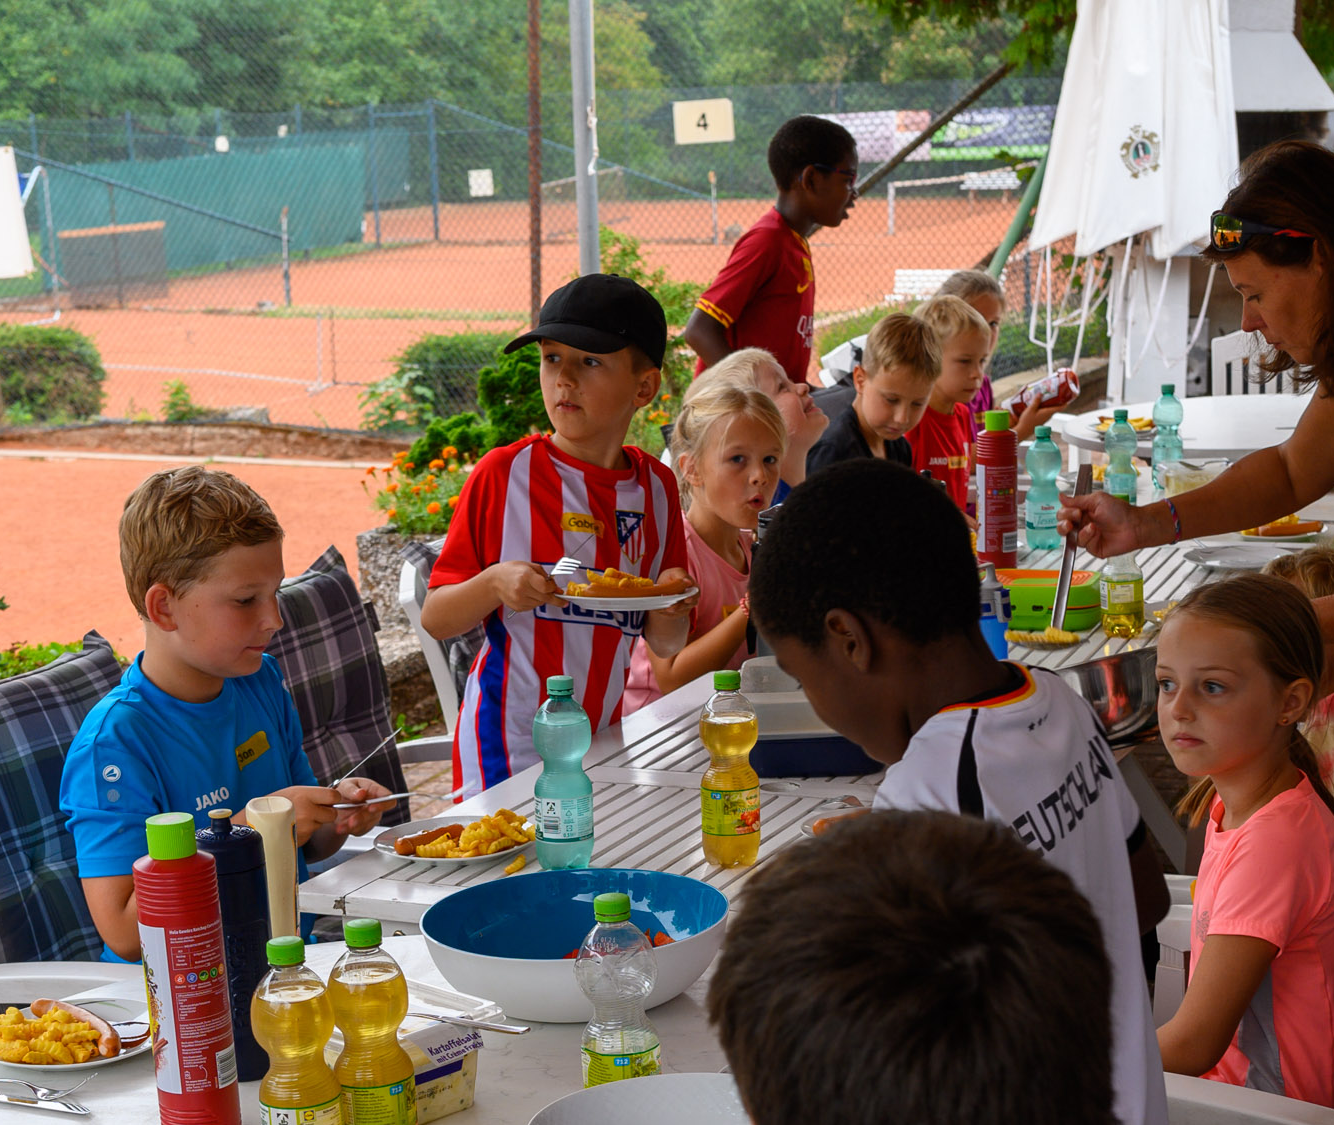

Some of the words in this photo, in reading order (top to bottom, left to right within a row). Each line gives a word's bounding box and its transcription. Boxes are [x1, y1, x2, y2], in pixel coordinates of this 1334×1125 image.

[696, 112, 709, 131] 4
[195, 786, 230, 811] JAKO
[1012, 735, 1114, 857] EUTSCHLAN
[427, 1031, 482, 1056] Kartoffelsalat
[436, 1055, 448, 1064] mit
